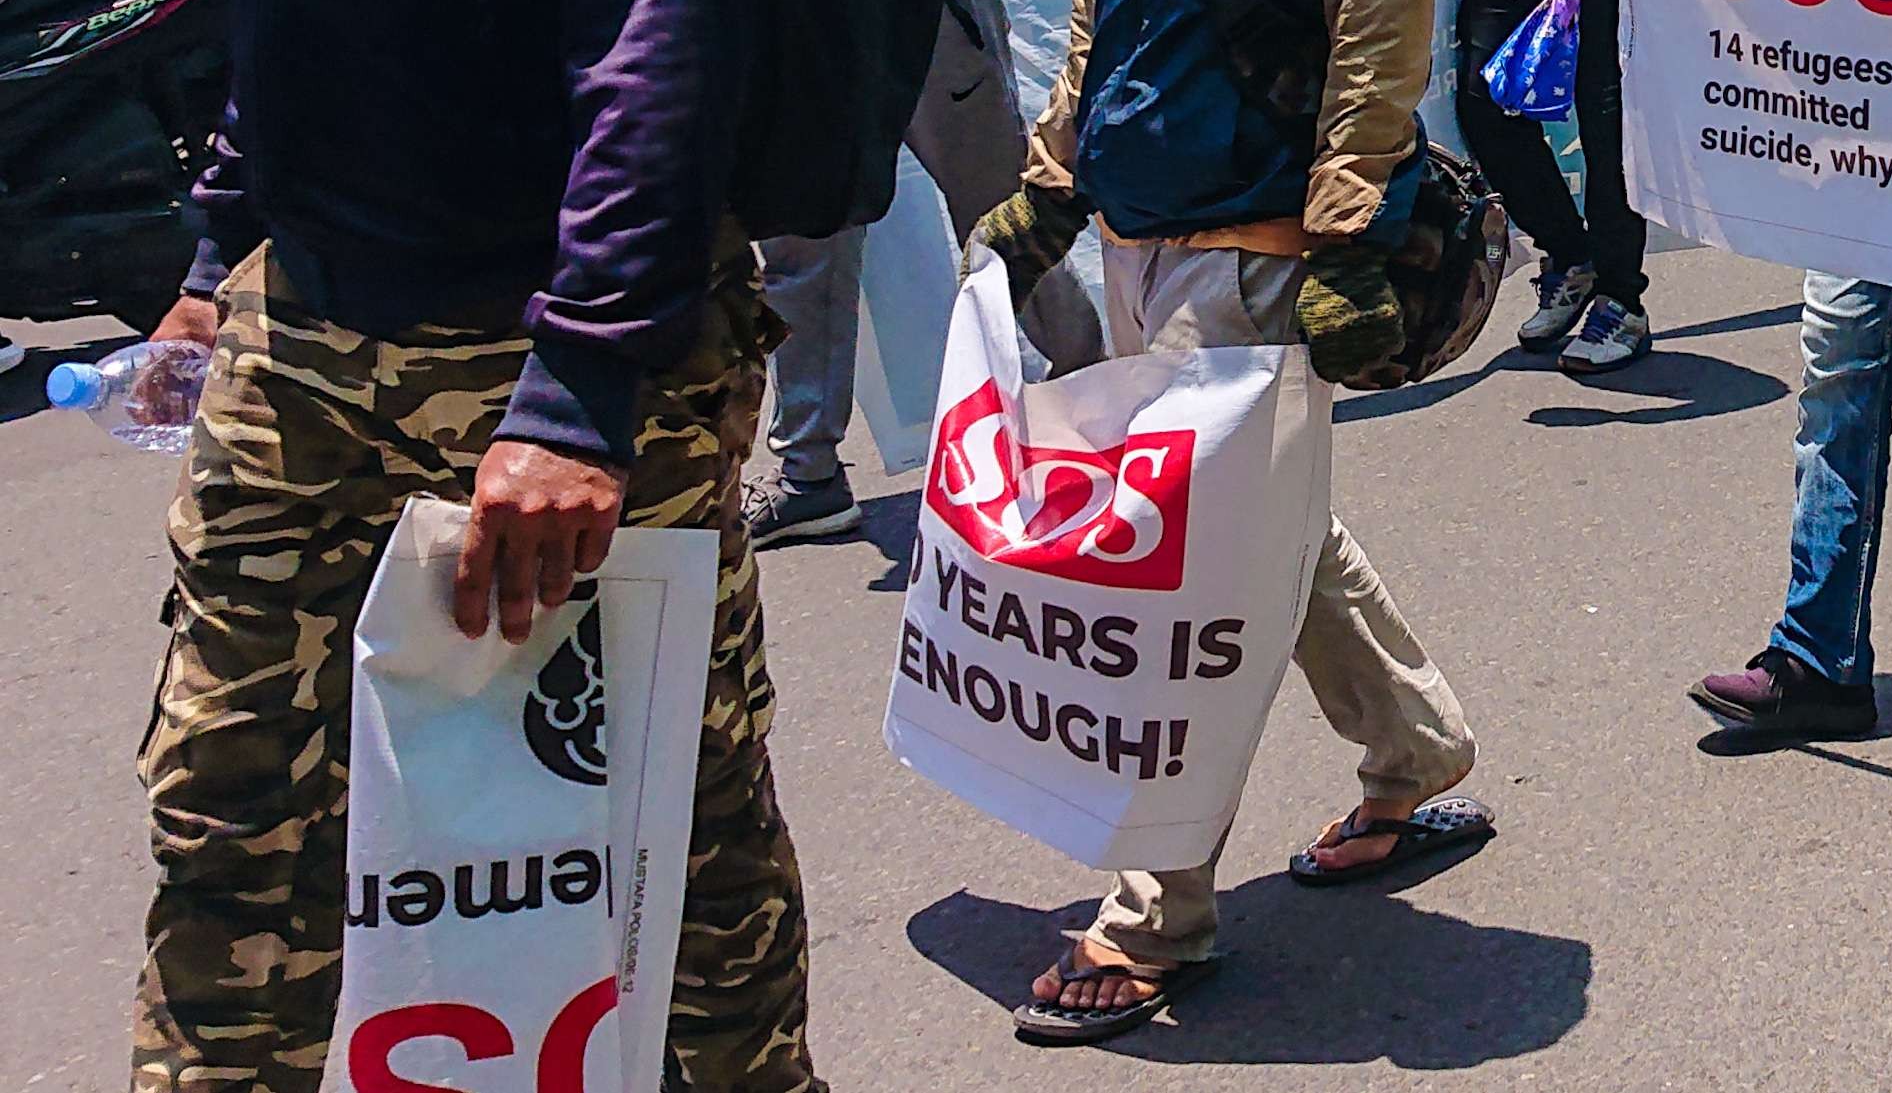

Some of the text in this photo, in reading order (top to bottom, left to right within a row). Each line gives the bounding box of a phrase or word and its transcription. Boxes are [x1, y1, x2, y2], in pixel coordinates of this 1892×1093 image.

[1709, 29, 1744, 62] 14
[1703, 80, 1870, 131] committed
[1700, 124, 1821, 175] suicide,
[937, 410, 1172, 564] SOS
[934, 545, 1139, 679] YEARS
[1168, 618, 1246, 681] IS
[899, 618, 1190, 780] ENOUGH!
[631, 848, 649, 910] MUSTAFA
